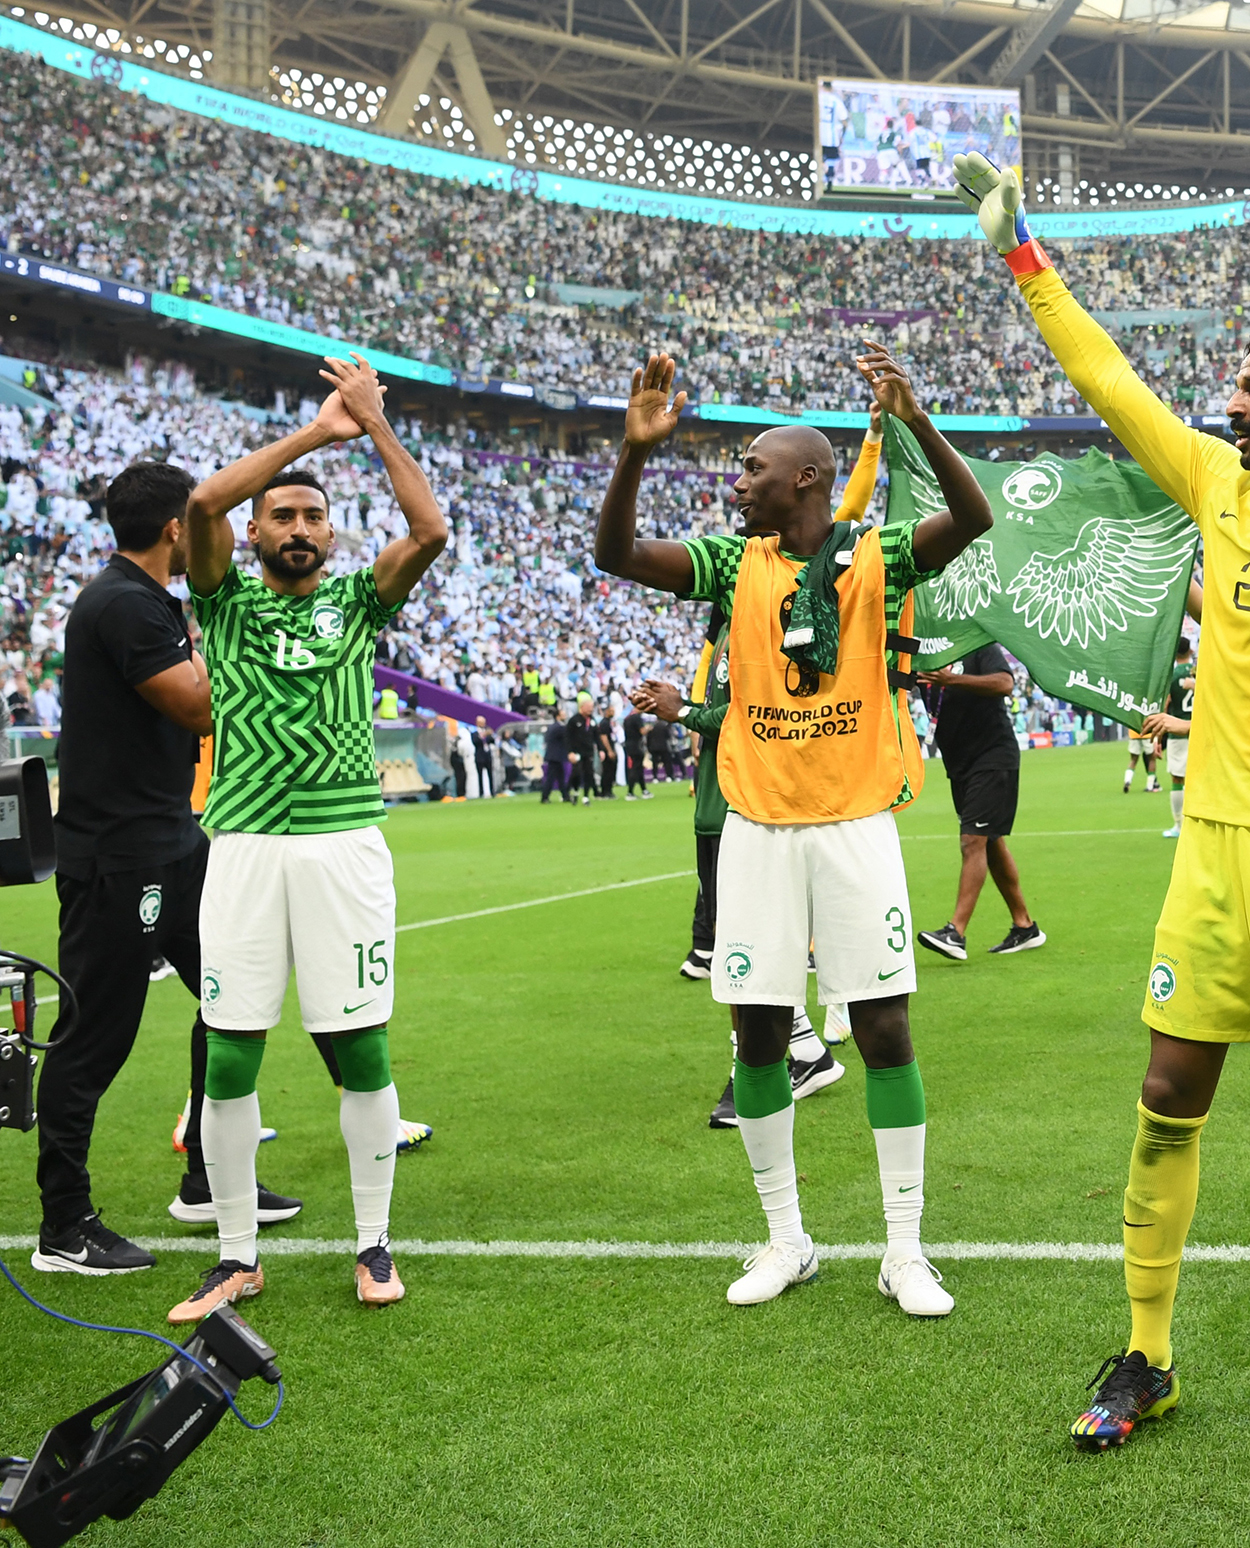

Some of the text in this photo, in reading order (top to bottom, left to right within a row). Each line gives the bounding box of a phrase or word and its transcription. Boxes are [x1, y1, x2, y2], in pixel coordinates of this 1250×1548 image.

[1005, 511, 1034, 526] KSA
[274, 628, 316, 670] 15
[748, 700, 862, 723] FIFA WORLD CUP
[752, 718, 858, 743] Qatar 2022
[885, 906, 907, 953] 3
[353, 940, 388, 989] 15
